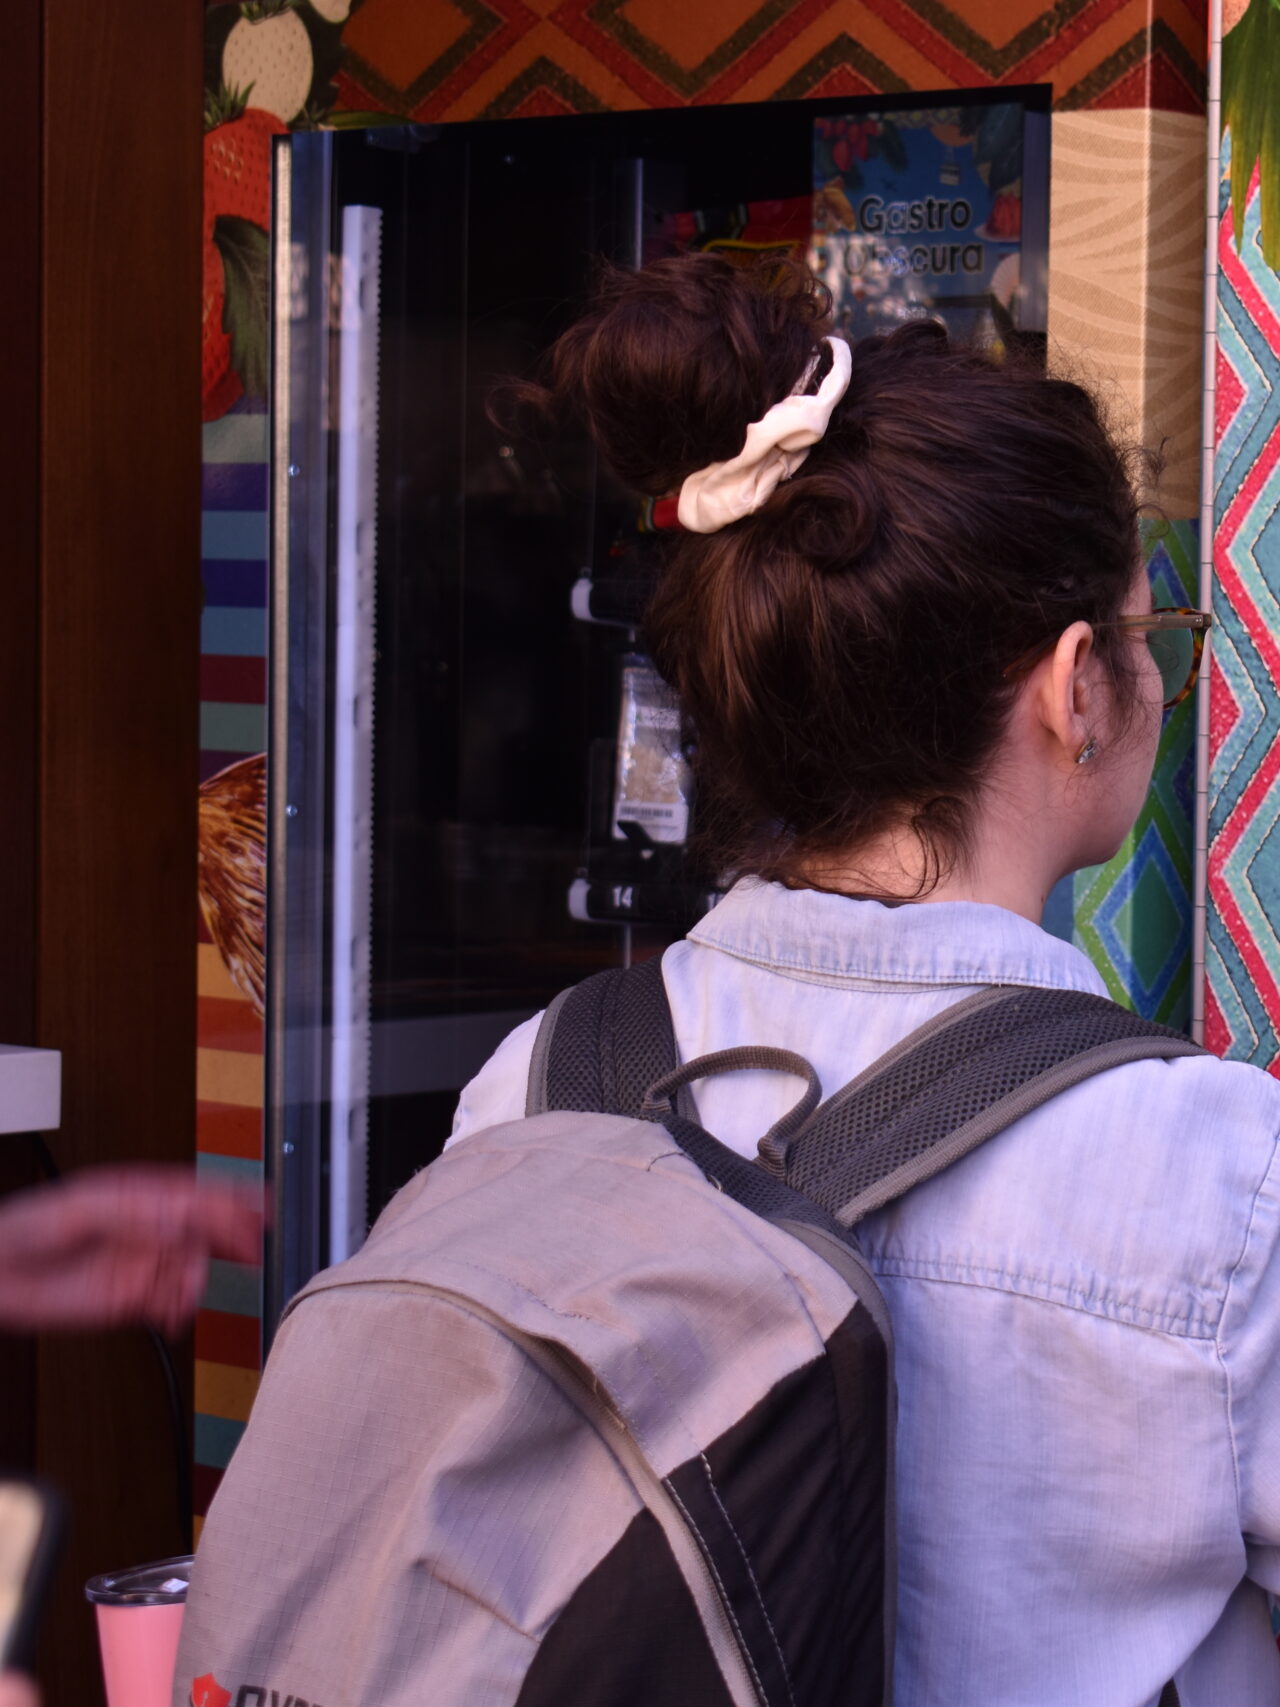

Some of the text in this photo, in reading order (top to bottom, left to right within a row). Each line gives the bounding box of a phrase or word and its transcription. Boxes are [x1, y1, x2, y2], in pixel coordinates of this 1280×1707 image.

[858, 193, 973, 234] Gastro
[843, 239, 985, 278] Obscura
[613, 886, 633, 908] 14
